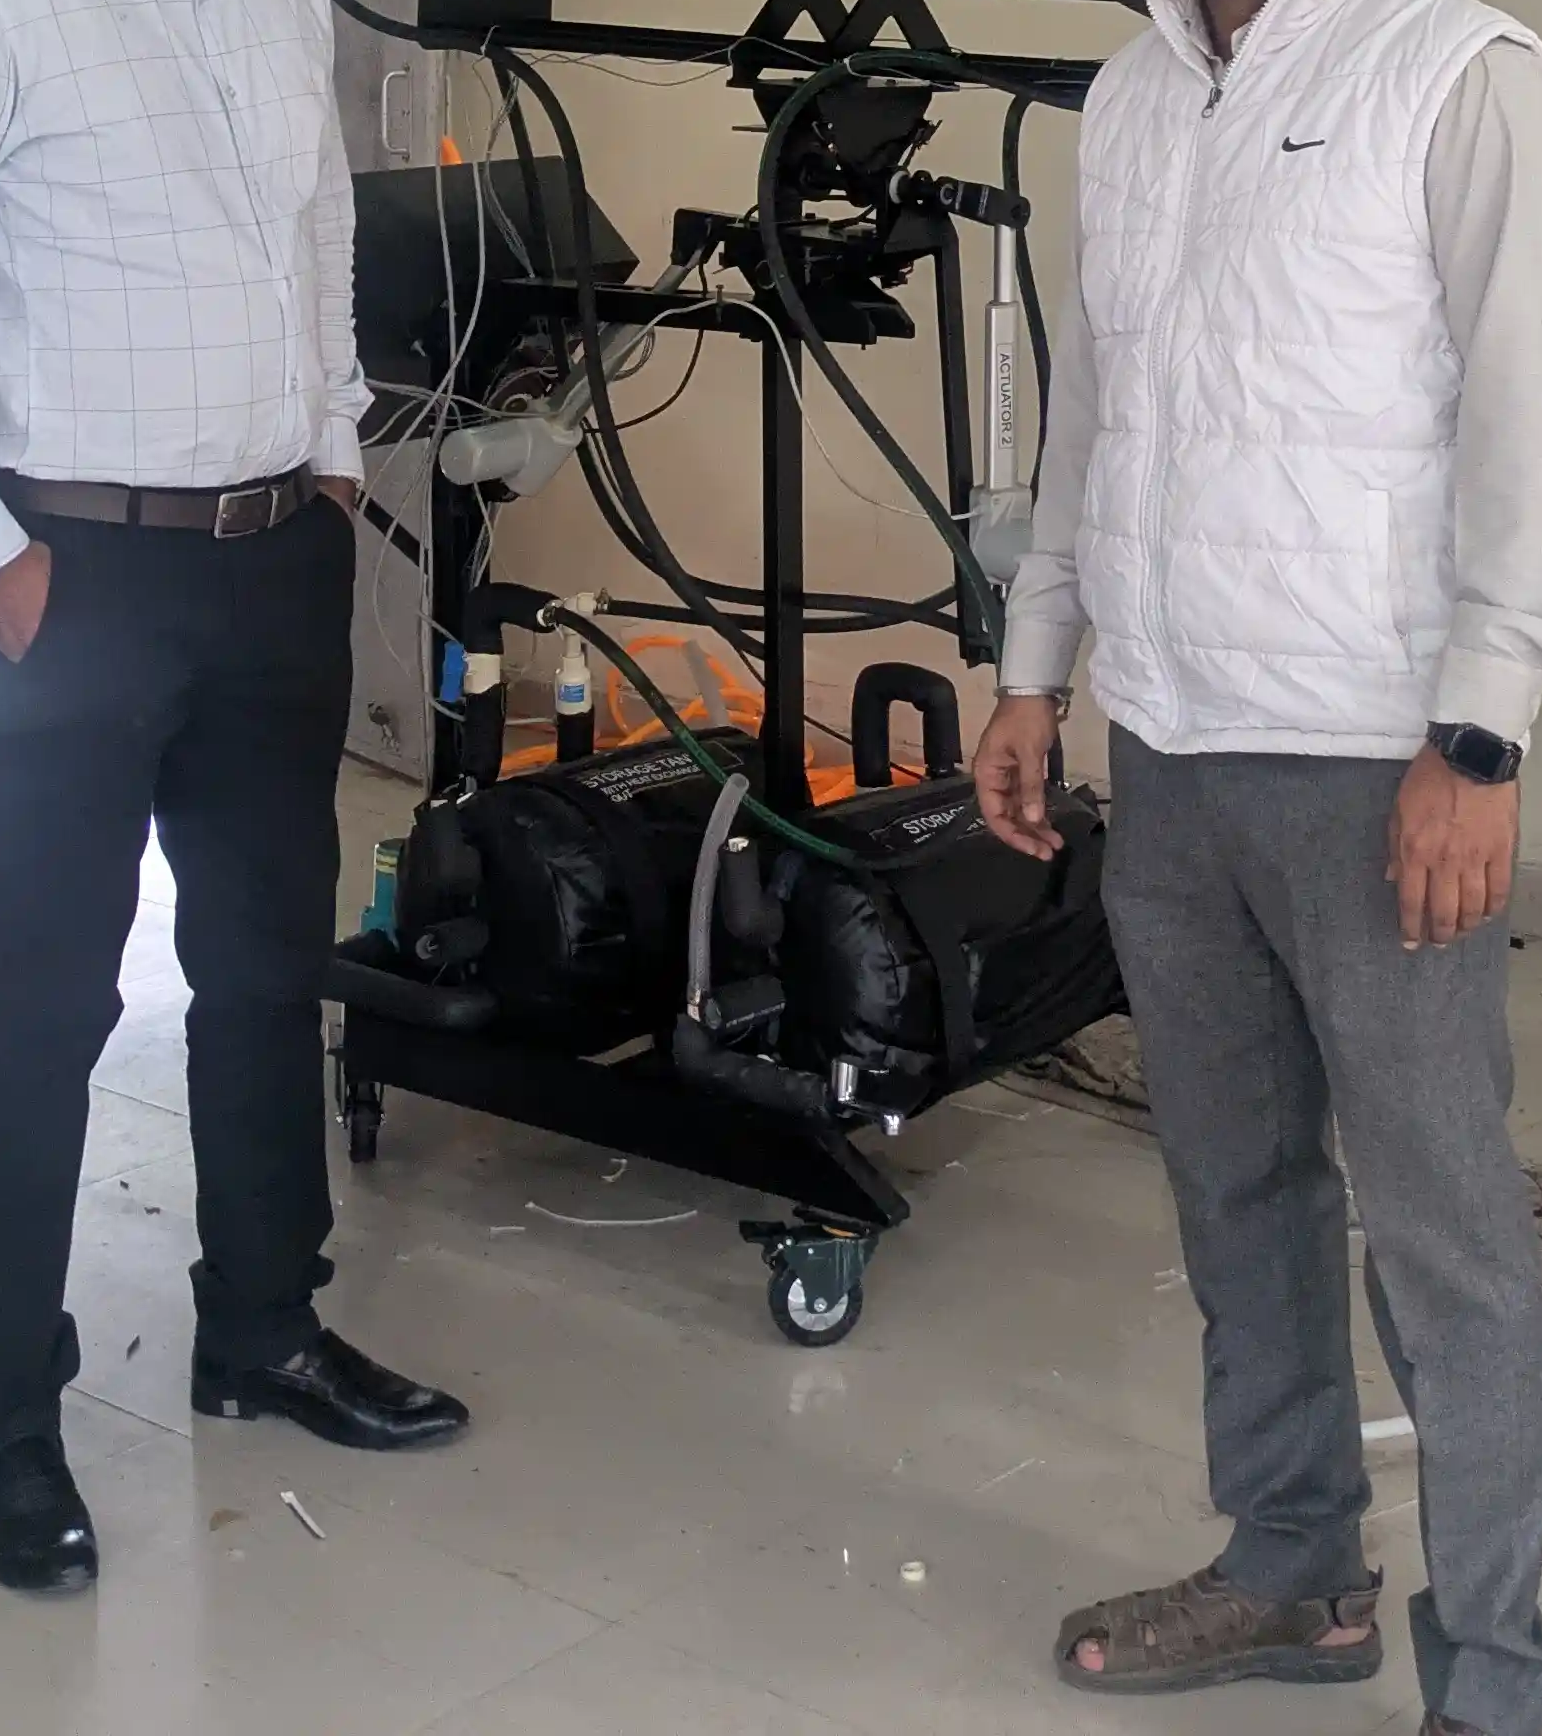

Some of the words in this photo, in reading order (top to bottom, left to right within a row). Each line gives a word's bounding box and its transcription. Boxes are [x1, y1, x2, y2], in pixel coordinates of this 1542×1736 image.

[999, 352, 1013, 433] ACTUATOR
[1001, 436, 1012, 445] 2
[582, 762, 662, 789] STORAGE
[656, 752, 693, 769] TAN
